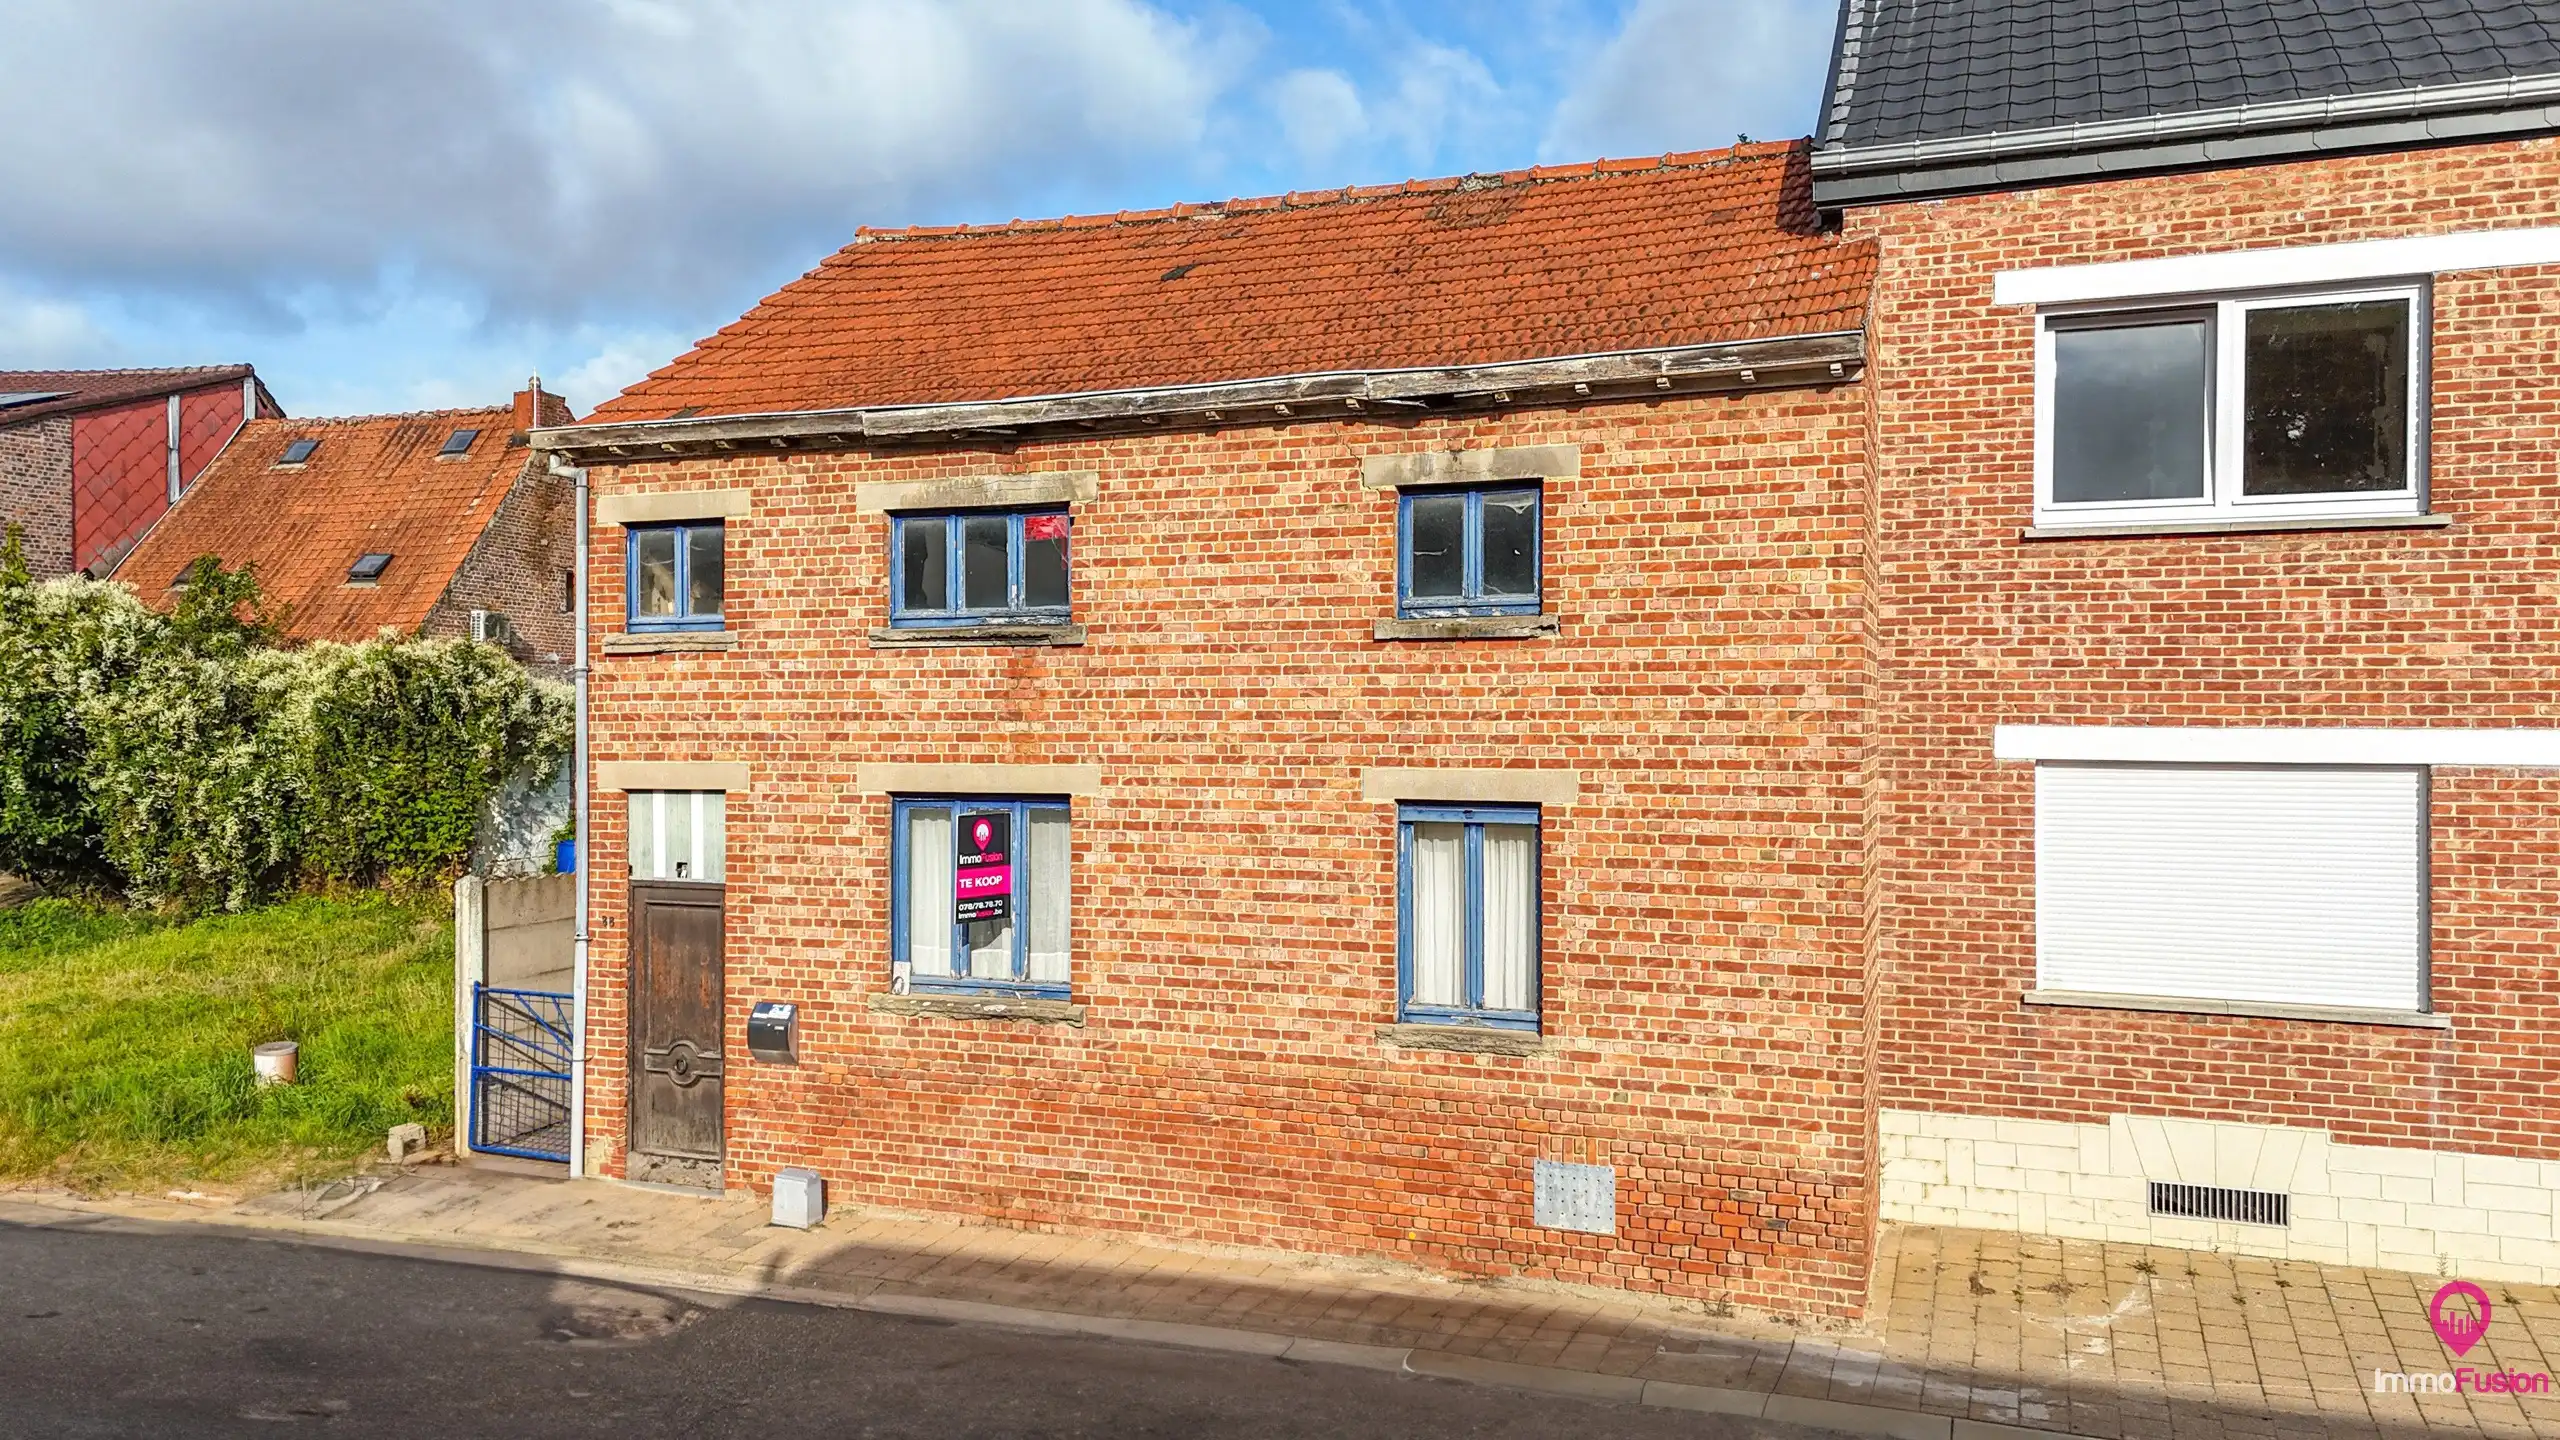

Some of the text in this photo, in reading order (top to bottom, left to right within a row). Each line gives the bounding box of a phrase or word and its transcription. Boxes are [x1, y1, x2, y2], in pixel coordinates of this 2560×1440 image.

[959, 875, 1003, 889] TE KOOP
[958, 899, 1003, 911] 078/78.78.70
